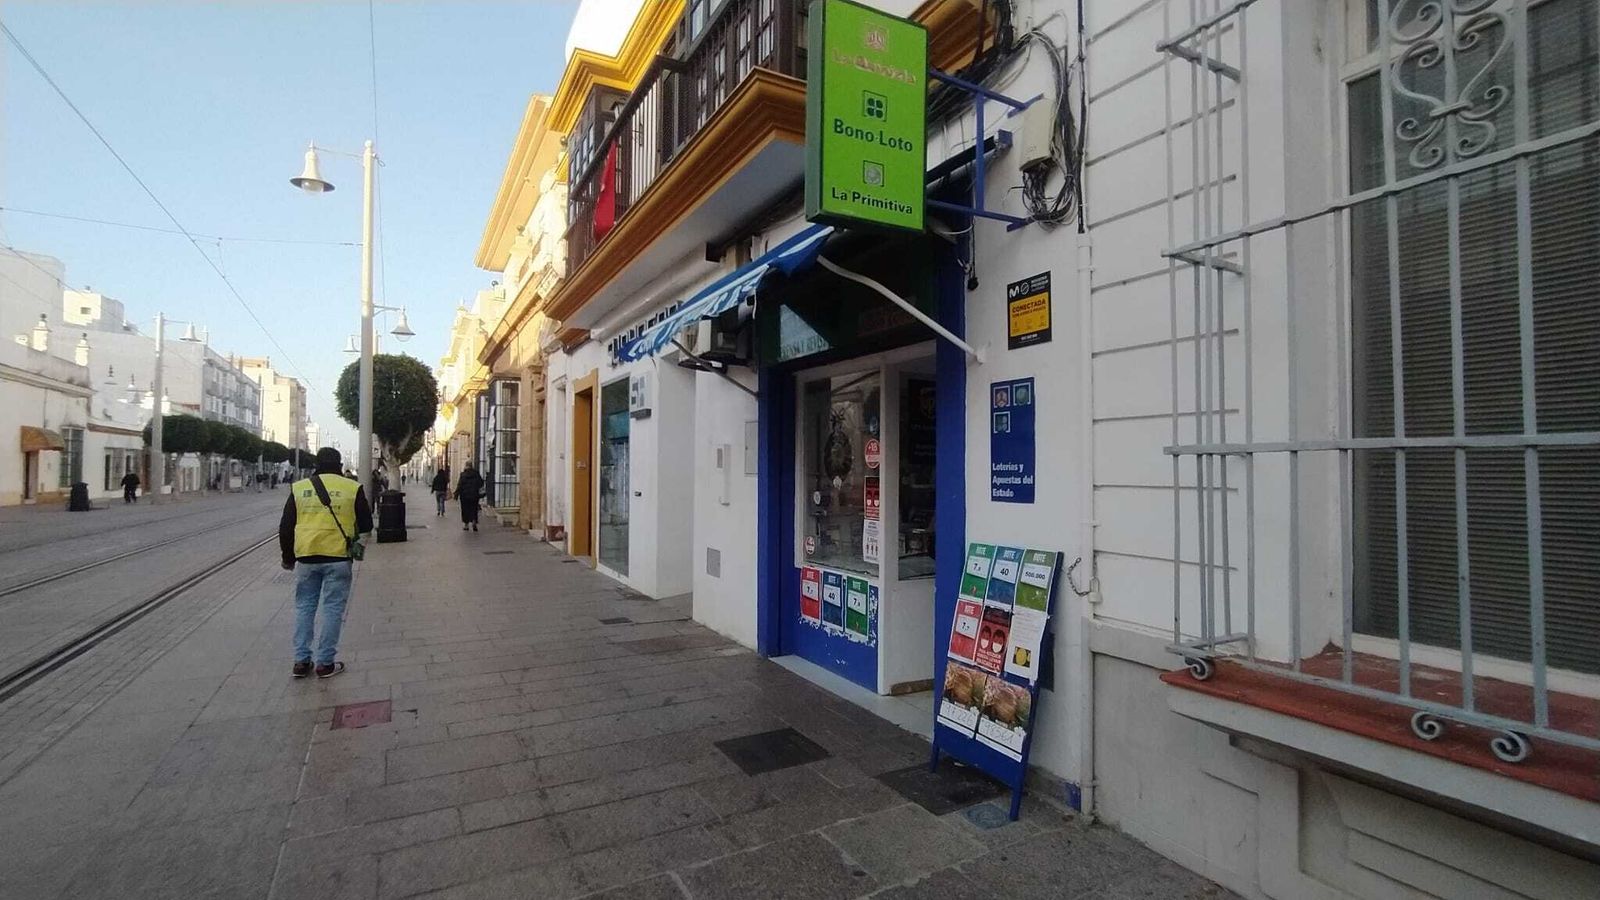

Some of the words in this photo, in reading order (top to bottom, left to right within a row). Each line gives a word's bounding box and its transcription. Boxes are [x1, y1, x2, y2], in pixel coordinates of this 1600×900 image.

[832, 187, 848, 201] La
[852, 191, 913, 214] Primitiva
[992, 475, 1021, 486] Apuestas
[1022, 475, 1034, 484] del
[992, 488, 1015, 497] Estado
[1000, 568, 1010, 576] 40
